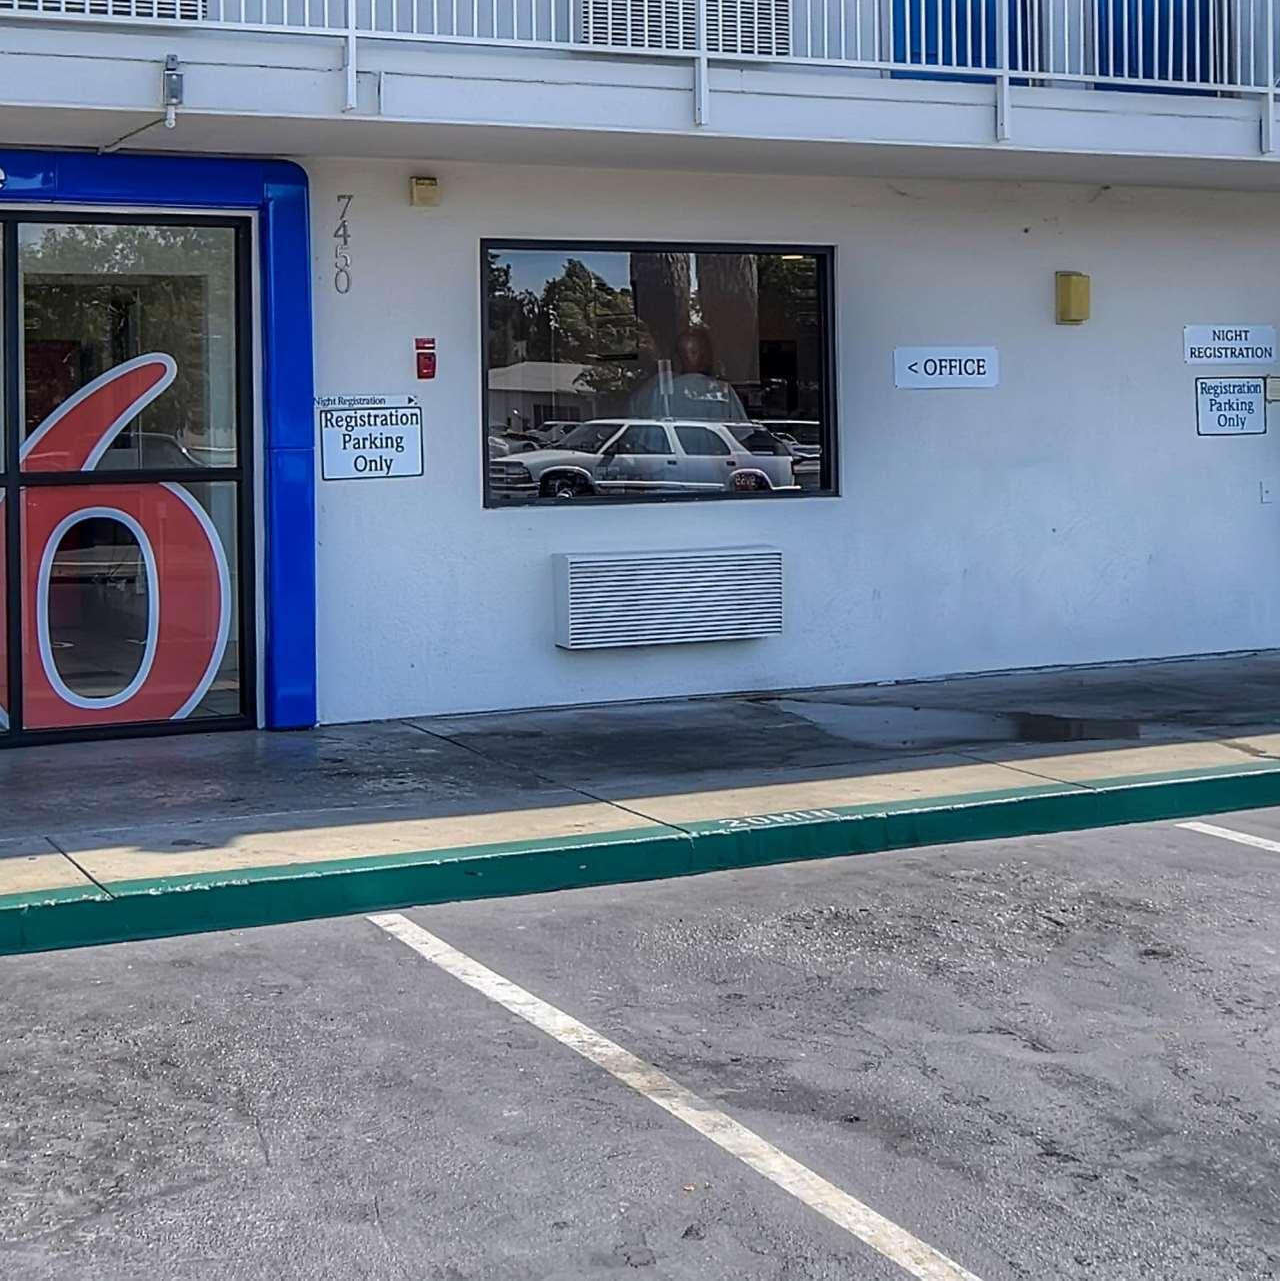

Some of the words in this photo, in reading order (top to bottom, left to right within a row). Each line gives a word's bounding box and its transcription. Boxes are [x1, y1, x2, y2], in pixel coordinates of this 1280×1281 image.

[334, 194, 353, 294] 7450
[1212, 329, 1250, 341] NIGHT
[1189, 346, 1273, 359] REGISTRATION
[923, 358, 986, 376] OFFICE
[1199, 381, 1262, 398] Registration
[315, 397, 336, 408] Night
[338, 395, 386, 408] Registration
[1209, 398, 1255, 414] Parking
[323, 409, 419, 432] Registration
[1217, 414, 1247, 430] Only
[342, 432, 405, 453] Parking
[354, 455, 394, 475] Only
